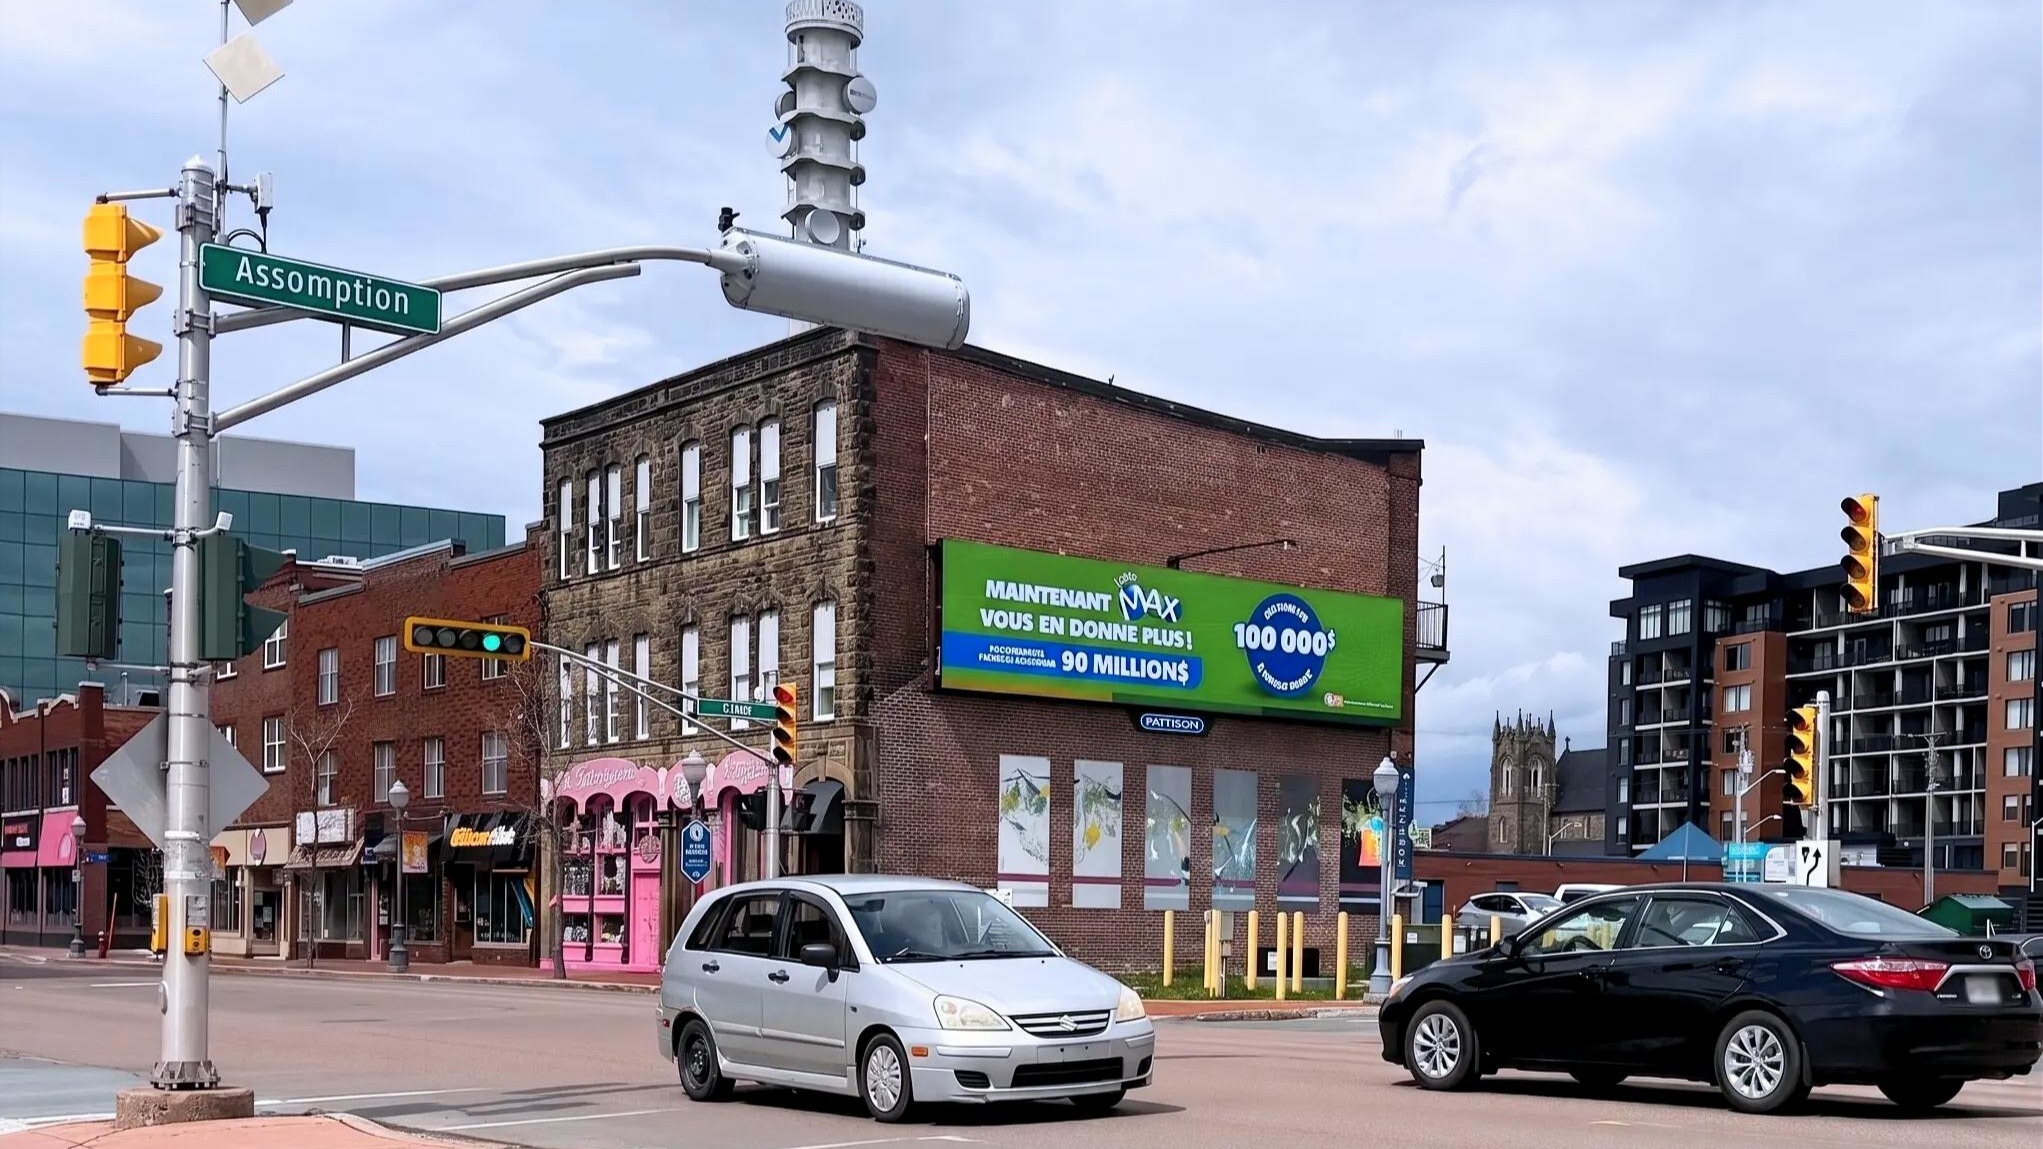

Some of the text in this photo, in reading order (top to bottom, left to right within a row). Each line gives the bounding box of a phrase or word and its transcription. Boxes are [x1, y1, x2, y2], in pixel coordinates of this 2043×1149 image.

[235, 256, 409, 315] Assomption
[985, 579, 1180, 623] MAINTENANT MAX
[979, 608, 1034, 632] VOUS
[1038, 615, 1065, 636] EN
[1069, 618, 1139, 644] DONNE
[1233, 622, 1336, 657] 100 000$
[1061, 650, 1088, 674] 90
[1093, 653, 1189, 686] MILLION$
[1145, 717, 1199, 730] PATTISON
